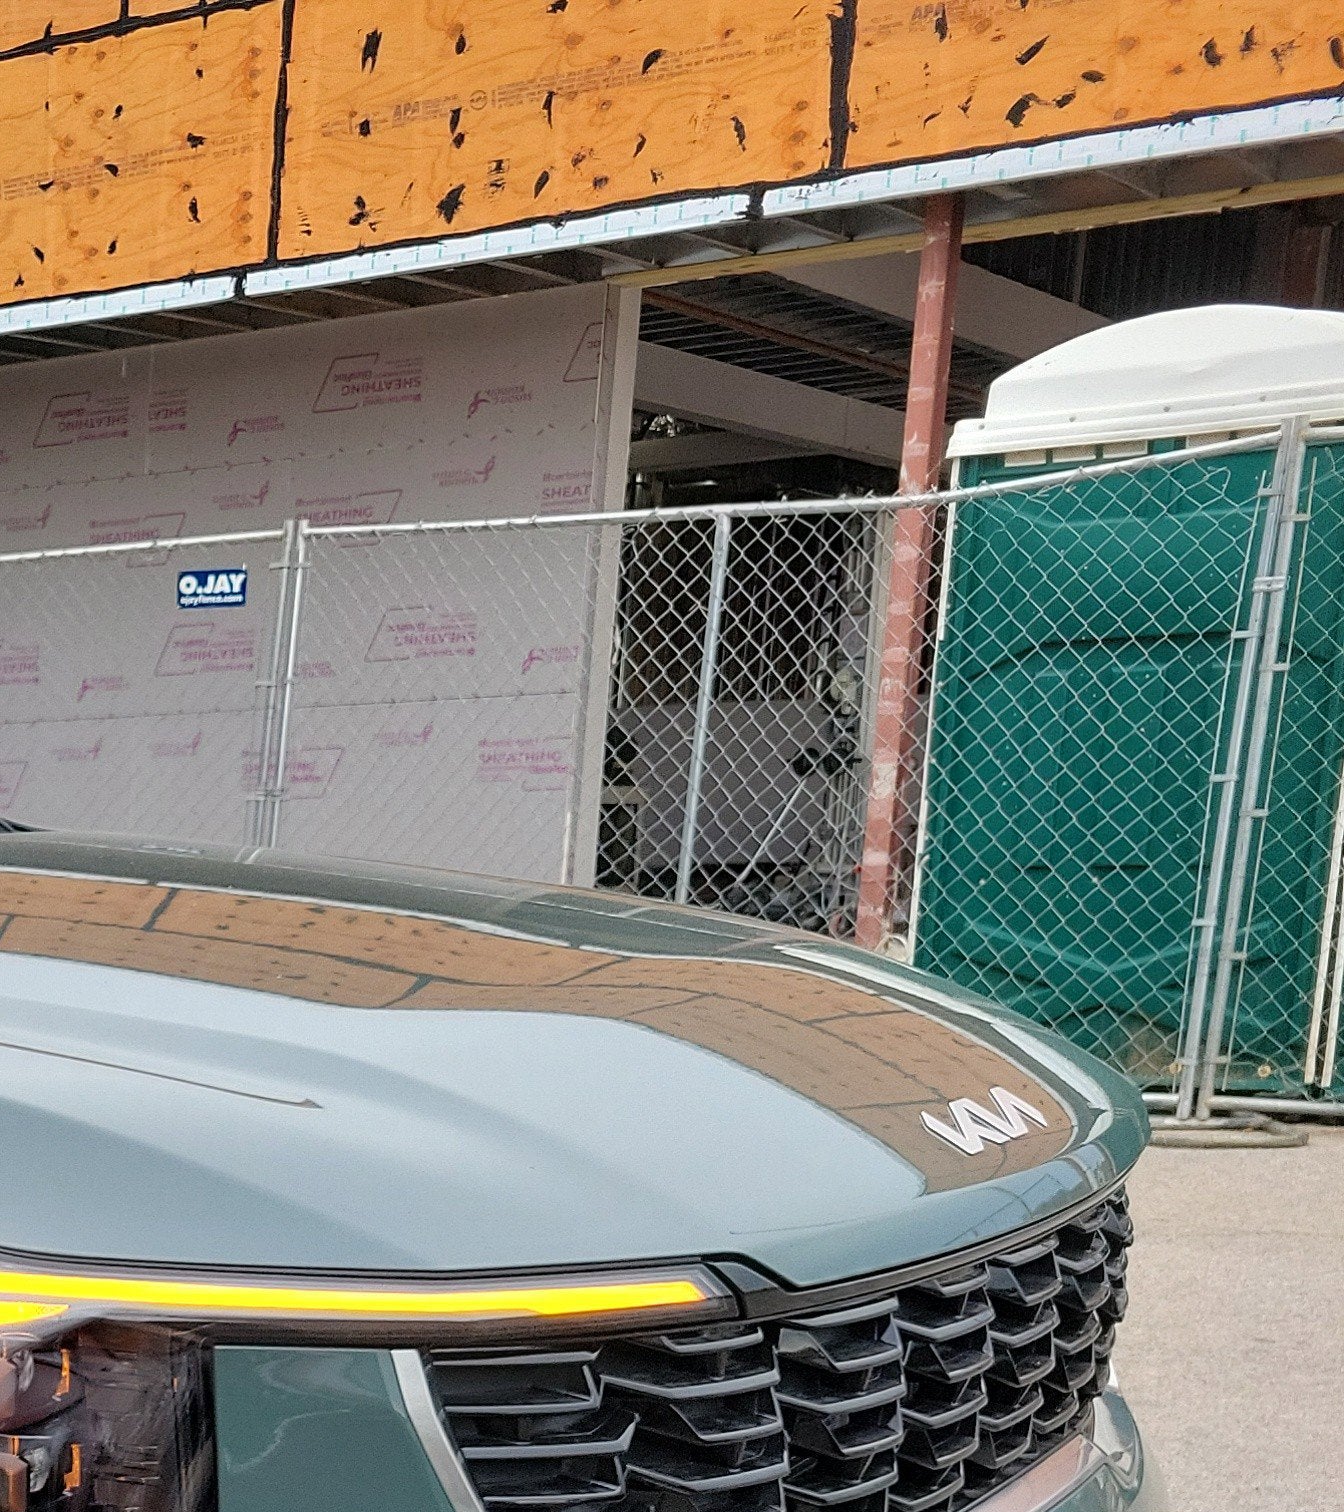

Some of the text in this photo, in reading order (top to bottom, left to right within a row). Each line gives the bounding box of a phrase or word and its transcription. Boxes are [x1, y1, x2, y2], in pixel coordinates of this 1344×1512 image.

[341, 376, 422, 397] SHEATHING
[542, 484, 591, 500] SHEAT
[179, 573, 246, 595] O.JAY
[920, 1086, 1048, 1156] KIA
